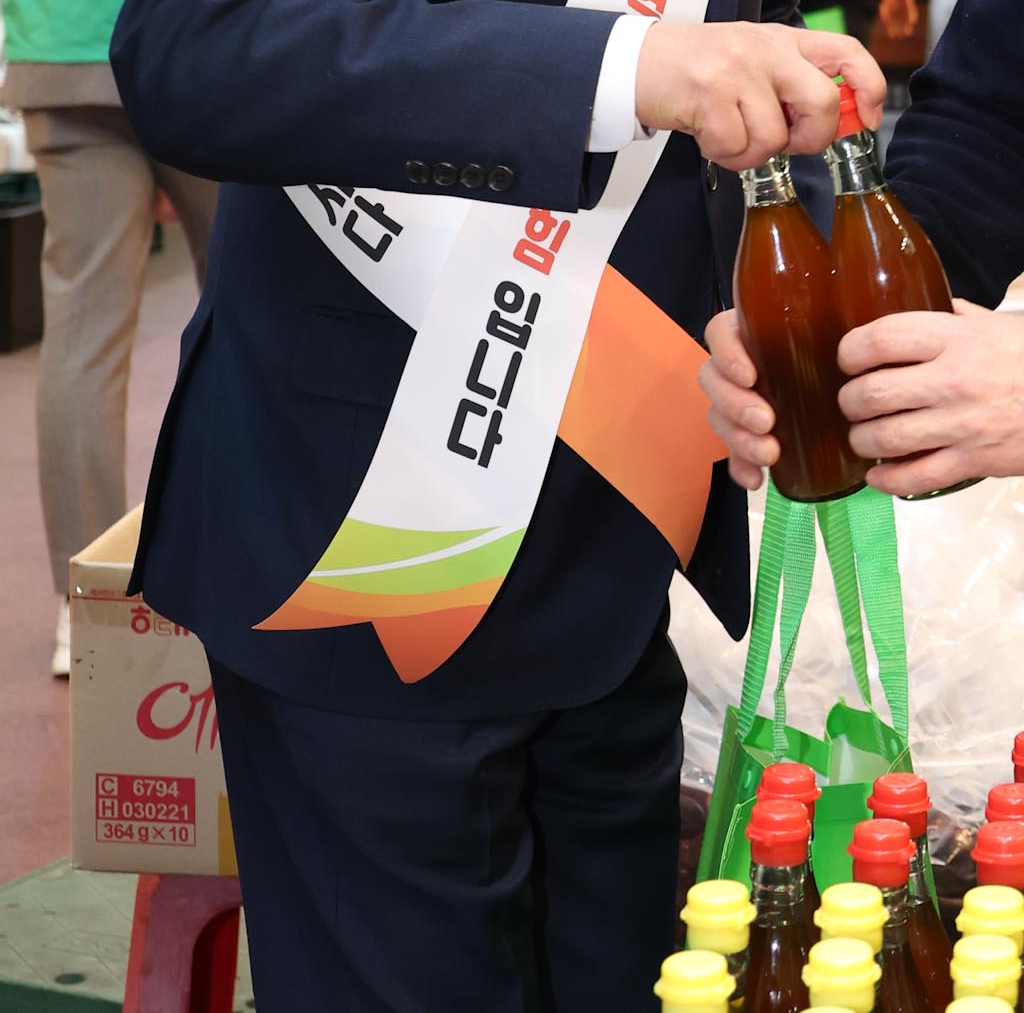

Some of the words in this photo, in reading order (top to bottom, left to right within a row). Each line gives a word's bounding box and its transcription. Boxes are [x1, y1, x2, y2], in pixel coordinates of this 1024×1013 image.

[513, 207, 571, 276] 힘
[101, 778, 115, 794] C
[132, 778, 179, 797] 6794
[101, 799, 115, 817] H
[122, 801, 189, 821] 030221
